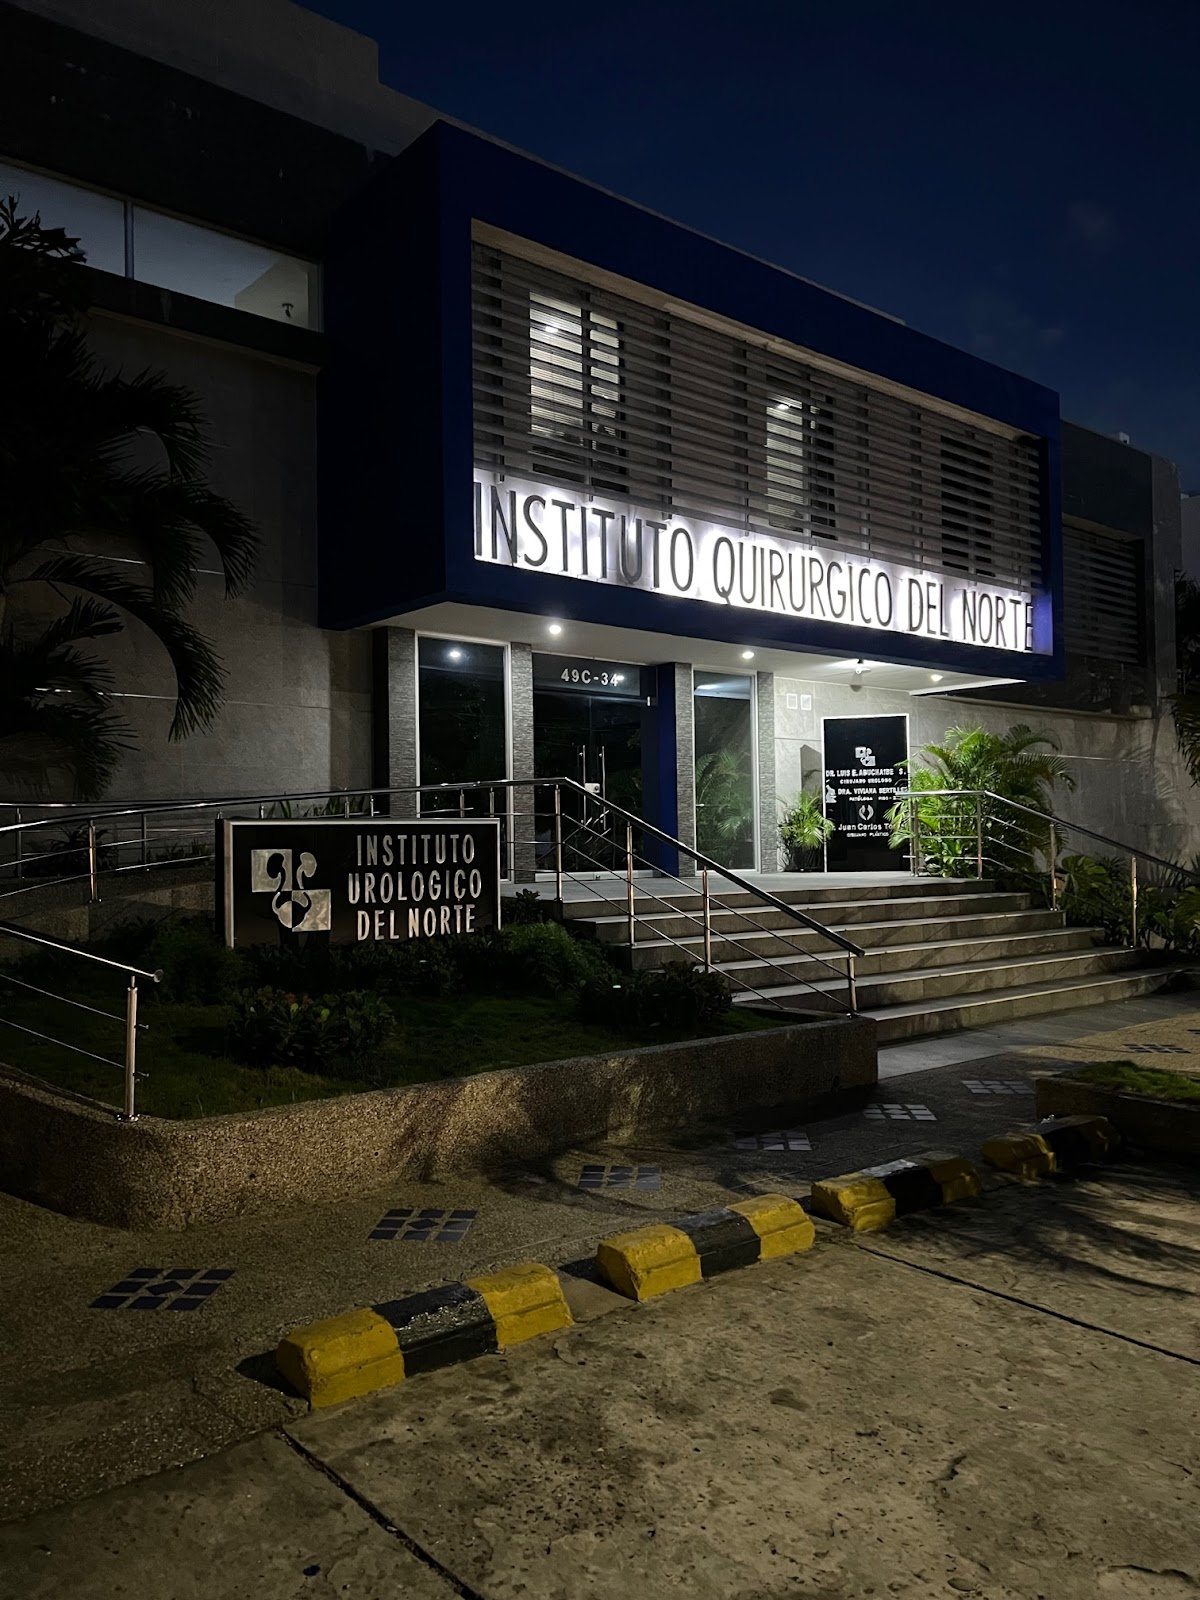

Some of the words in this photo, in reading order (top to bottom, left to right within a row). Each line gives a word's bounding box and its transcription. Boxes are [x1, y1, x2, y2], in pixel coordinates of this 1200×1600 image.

[474, 481, 694, 592] INSTITUTO
[712, 536, 893, 626] QUIRURGICO
[907, 578, 950, 636] DEL
[963, 589, 1034, 652] NORTE
[560, 668, 619, 687] 49C-34
[356, 834, 475, 866] INSTITUTO
[348, 868, 482, 904] UROLOGICO
[357, 909, 400, 941] DEL
[408, 904, 476, 939] NORTE
